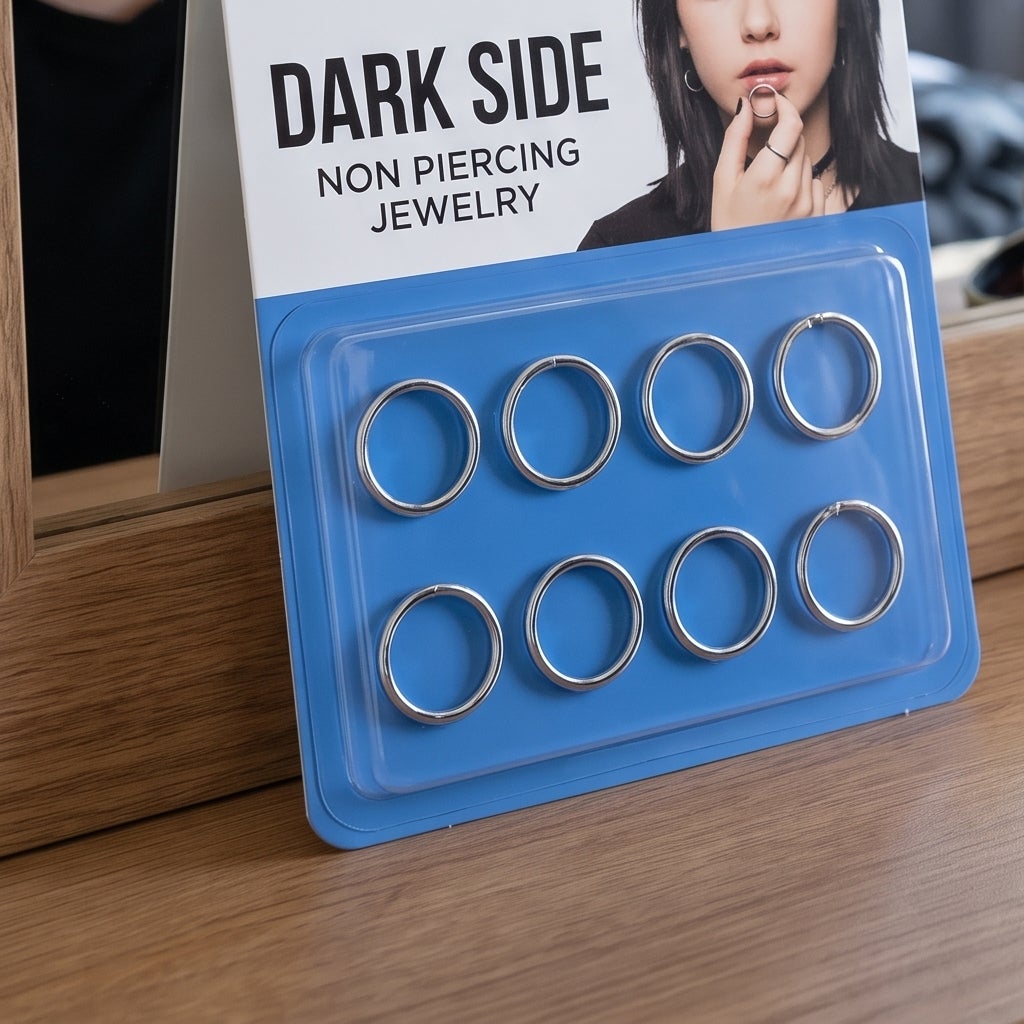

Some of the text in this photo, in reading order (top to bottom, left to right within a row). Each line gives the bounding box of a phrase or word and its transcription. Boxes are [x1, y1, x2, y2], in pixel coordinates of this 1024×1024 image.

[269, 30, 610, 150] DARK SIDE
[317, 137, 580, 198] NON PIERCING
[370, 182, 540, 233] JEWELRY
